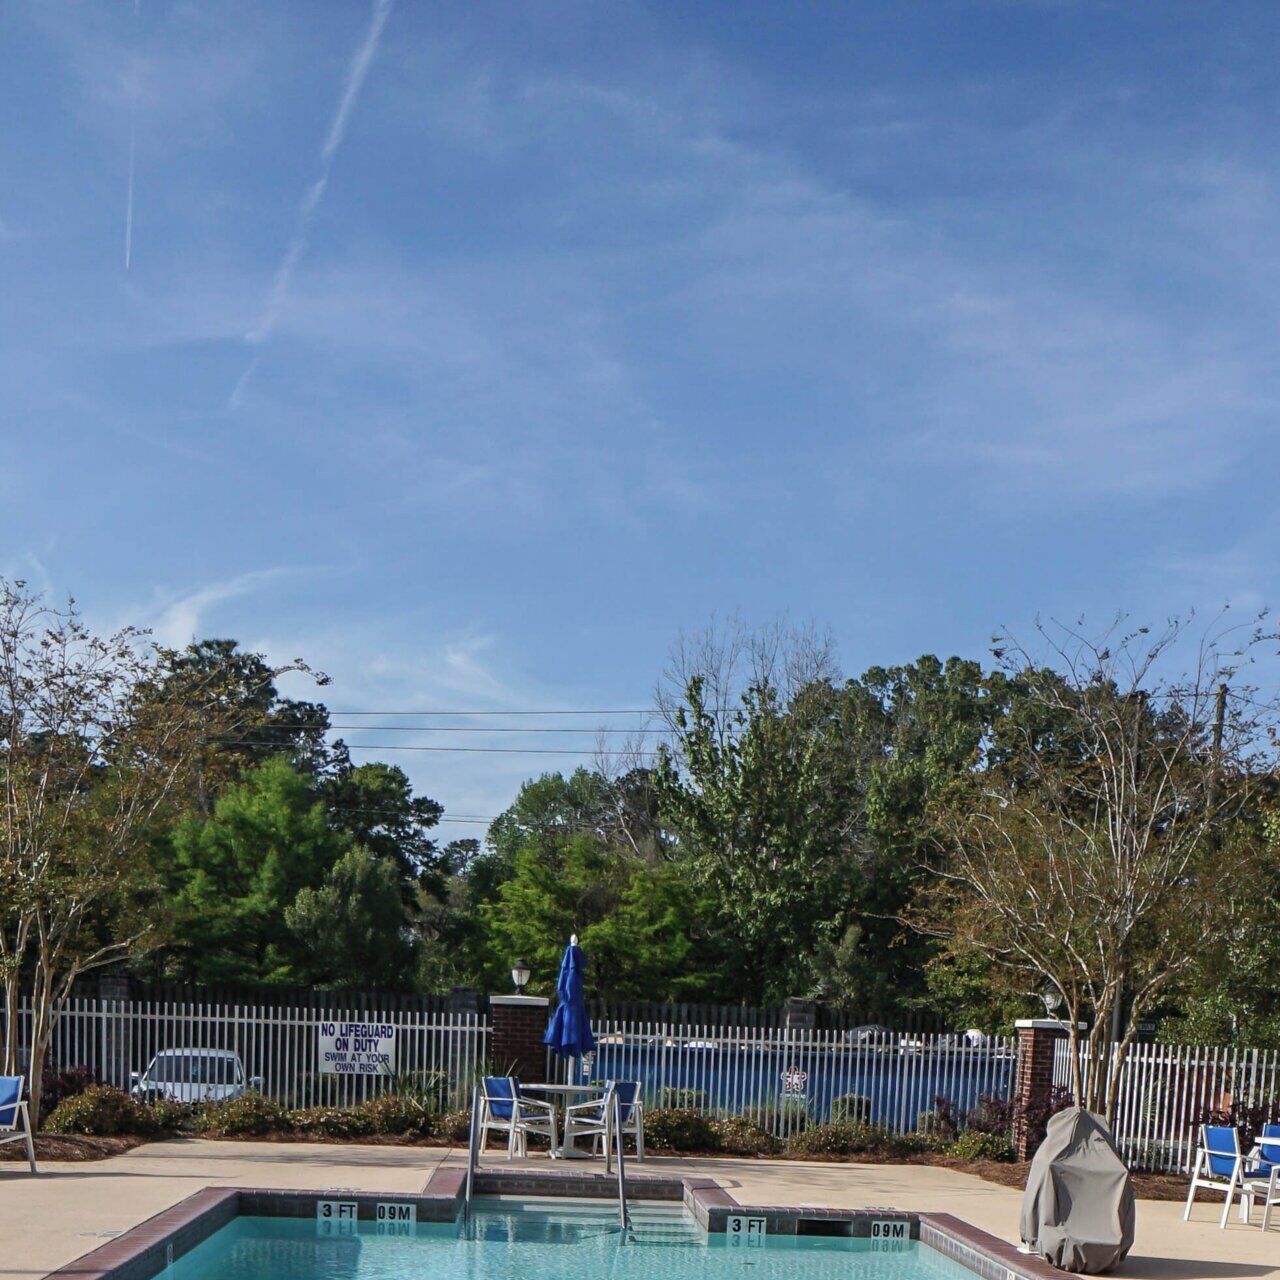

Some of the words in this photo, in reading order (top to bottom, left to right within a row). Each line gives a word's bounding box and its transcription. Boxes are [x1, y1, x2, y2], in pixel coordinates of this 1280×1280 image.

[321, 1023, 336, 1037] NO
[340, 1024, 394, 1039] LIFEGUARD
[335, 1038, 349, 1052] ON
[354, 1038, 380, 1052] DUTY
[324, 1052, 347, 1062] SWIM
[350, 1053, 362, 1063] AT
[366, 1053, 390, 1064] YOUR
[334, 1062, 356, 1072] OWN
[359, 1063, 379, 1073] RISK
[322, 1203, 332, 1218] 3
[339, 1204, 356, 1219] FT
[732, 1218, 742, 1233] 3
[748, 1219, 765, 1234] FT
